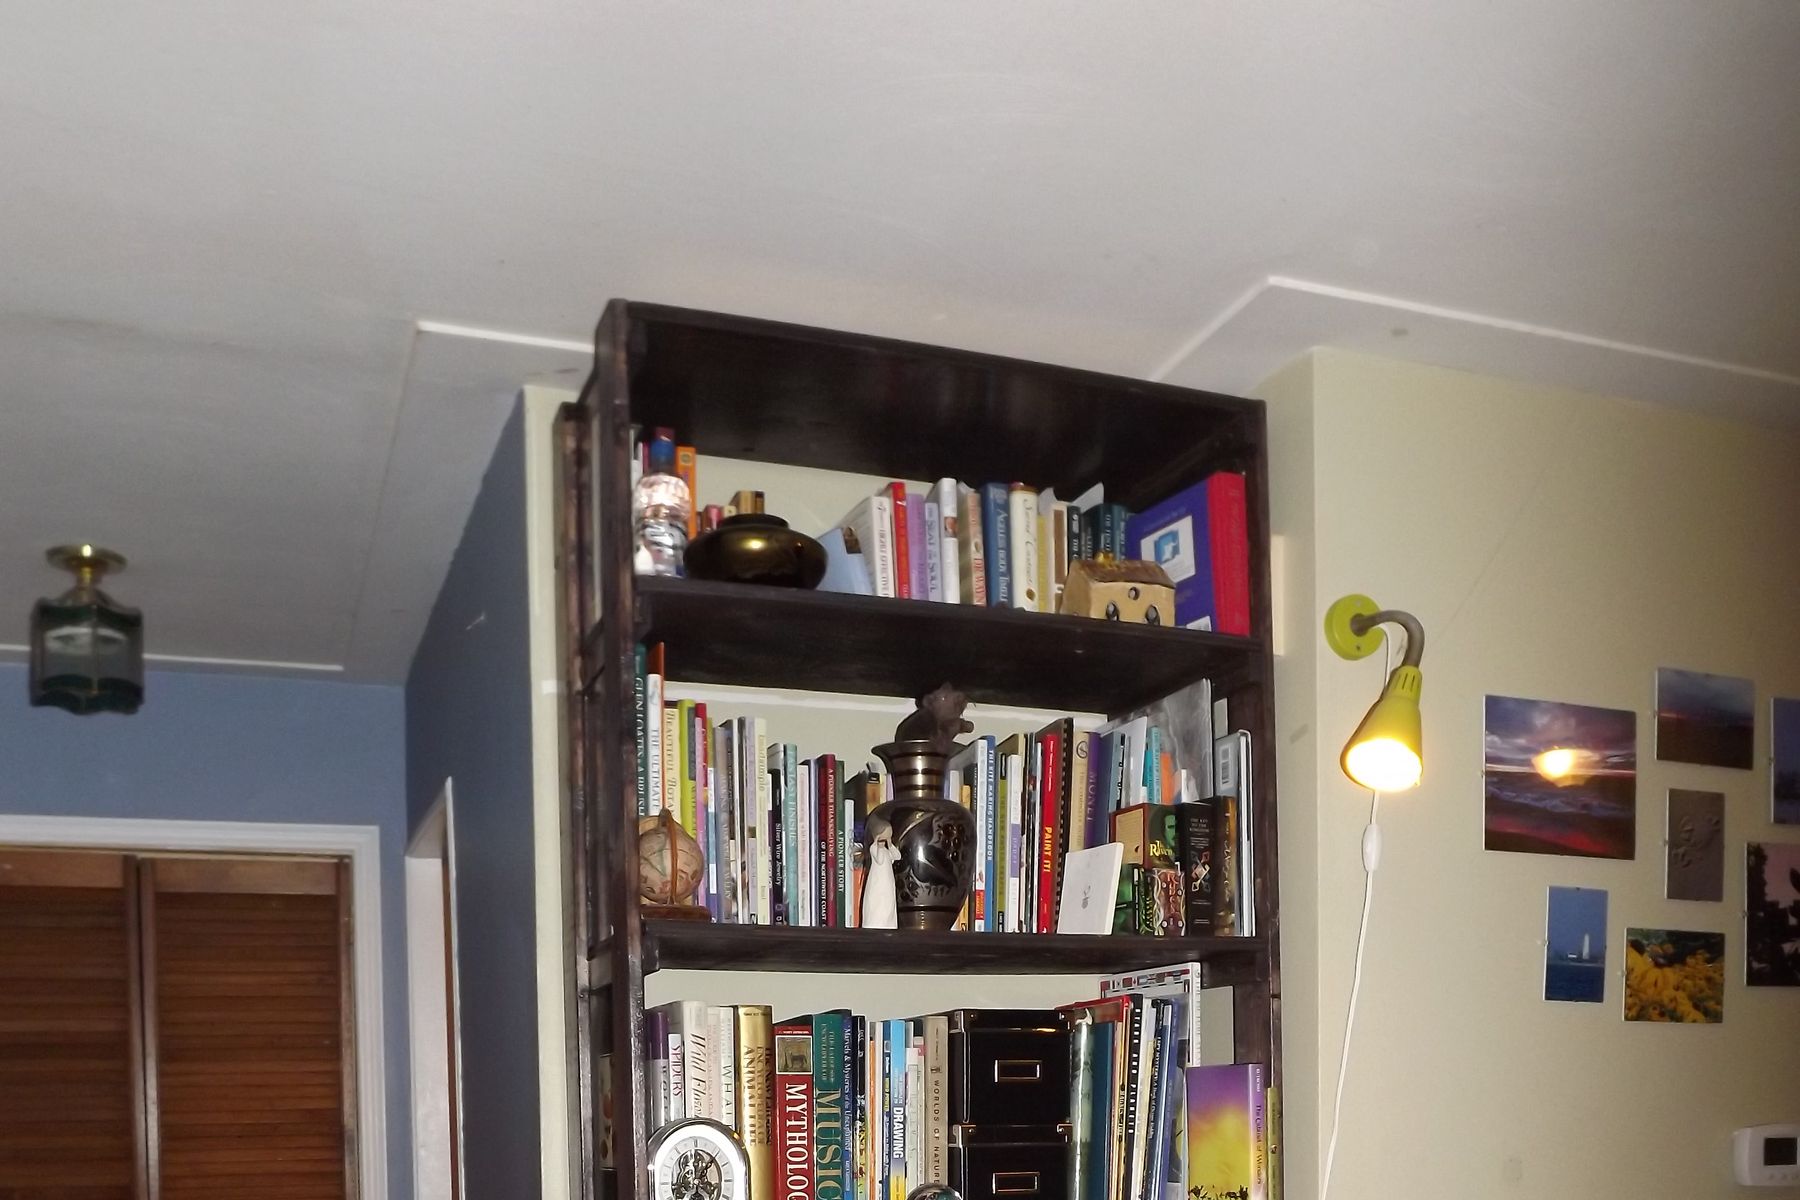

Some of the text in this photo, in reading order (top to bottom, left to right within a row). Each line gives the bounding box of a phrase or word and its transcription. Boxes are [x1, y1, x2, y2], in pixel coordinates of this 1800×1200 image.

[933, 1079, 941, 1122] WORLDS
[816, 1087, 842, 1200] MUSIC
[893, 1106, 904, 1158] DRAWING
